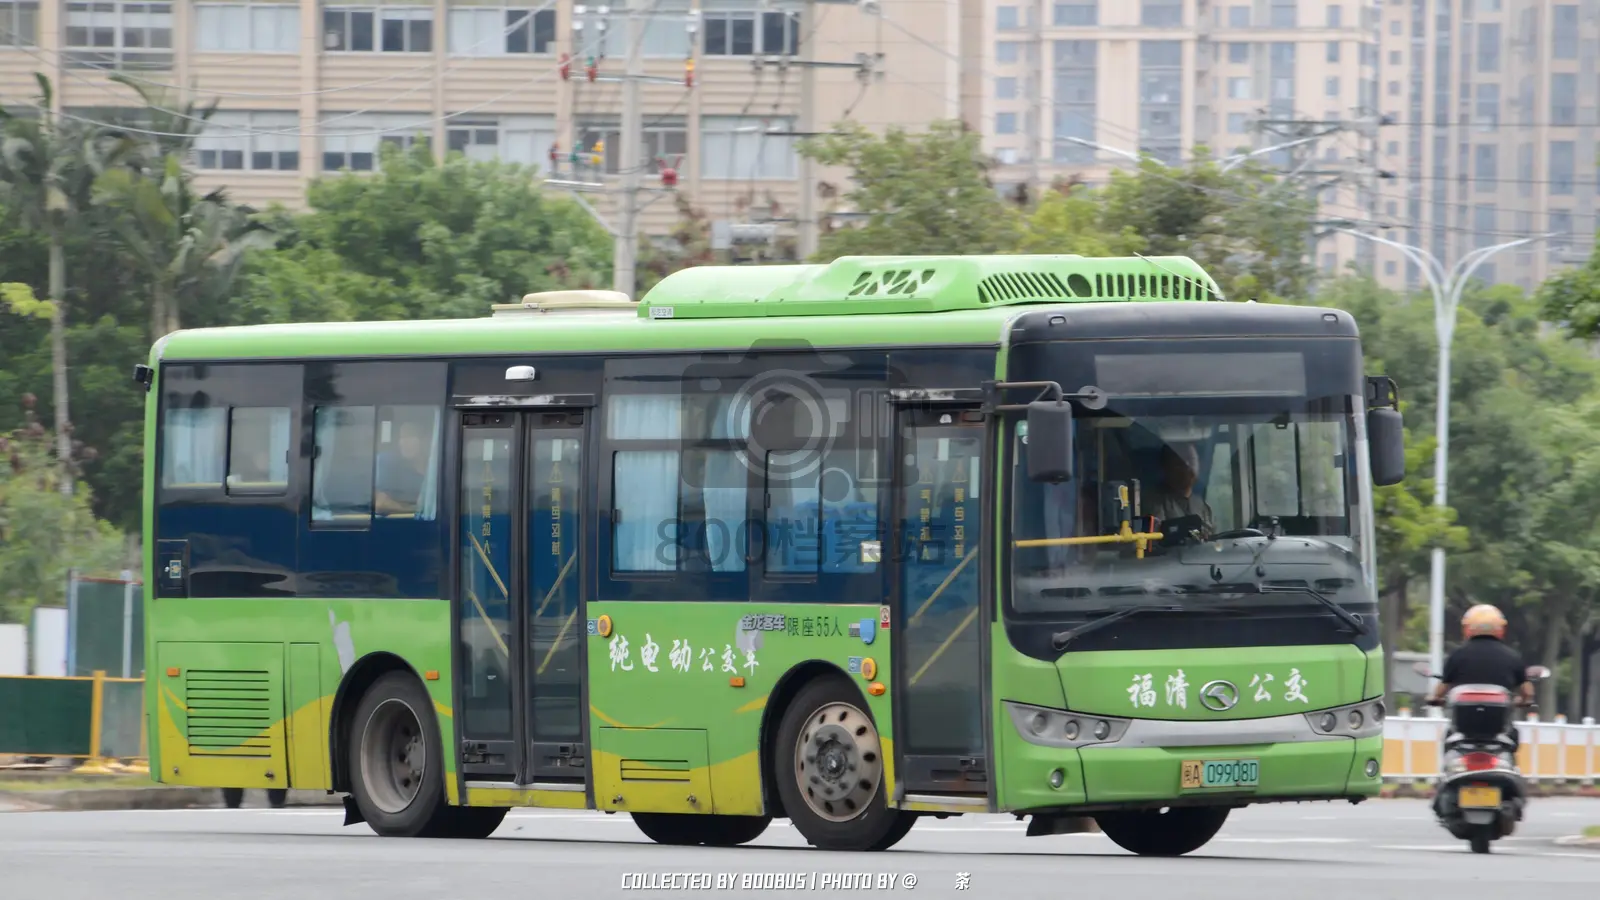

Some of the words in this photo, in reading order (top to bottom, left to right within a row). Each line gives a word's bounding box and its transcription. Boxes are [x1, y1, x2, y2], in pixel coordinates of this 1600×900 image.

[741, 613, 786, 631] 金龙客车
[787, 616, 843, 637] 限座55人
[1126, 669, 1190, 709] 福清
[1249, 668, 1309, 704] 公交
